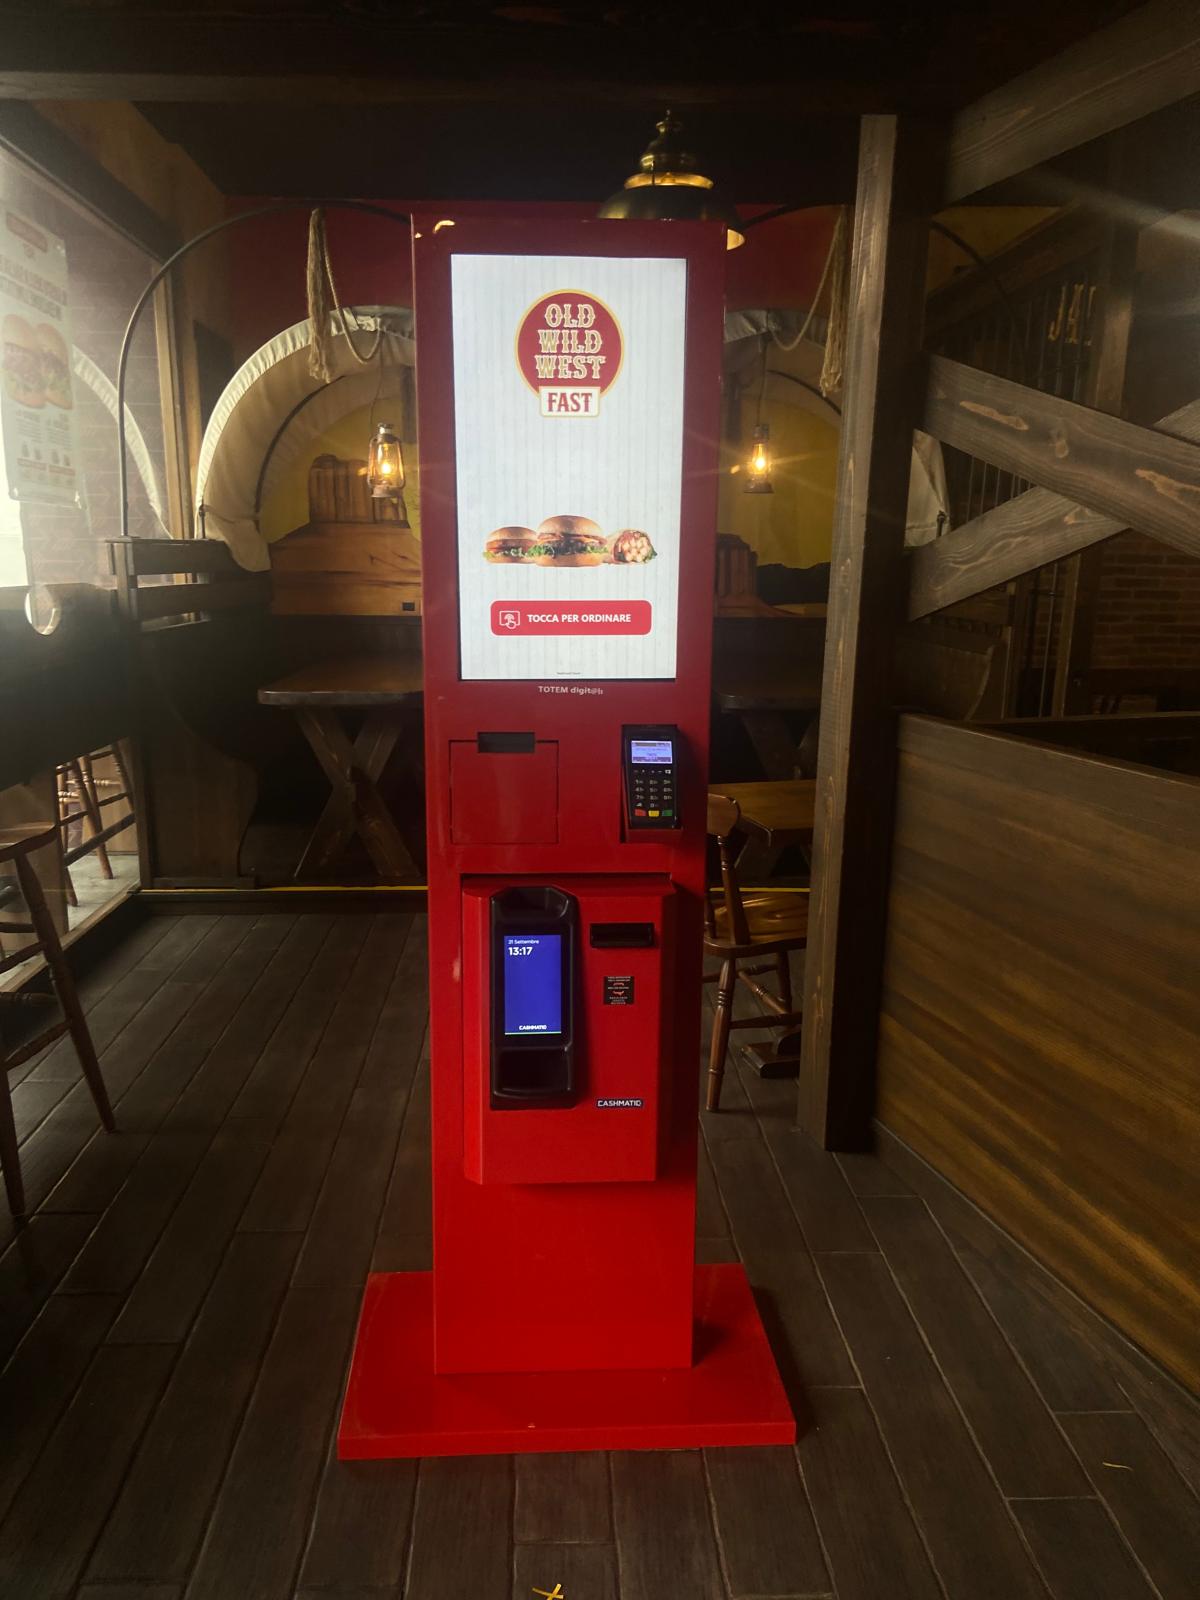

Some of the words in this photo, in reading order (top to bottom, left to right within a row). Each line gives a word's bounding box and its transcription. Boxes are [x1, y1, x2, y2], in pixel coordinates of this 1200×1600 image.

[544, 303, 596, 328] OLD
[537, 329, 603, 354] WILD
[534, 355, 606, 379] WEST
[547, 392, 593, 412] FAST
[527, 614, 559, 623] TOCCA
[561, 614, 580, 623] PER
[581, 614, 632, 623] ORDINARE
[538, 686, 569, 694] TOTEM
[508, 946, 533, 956] 13:17
